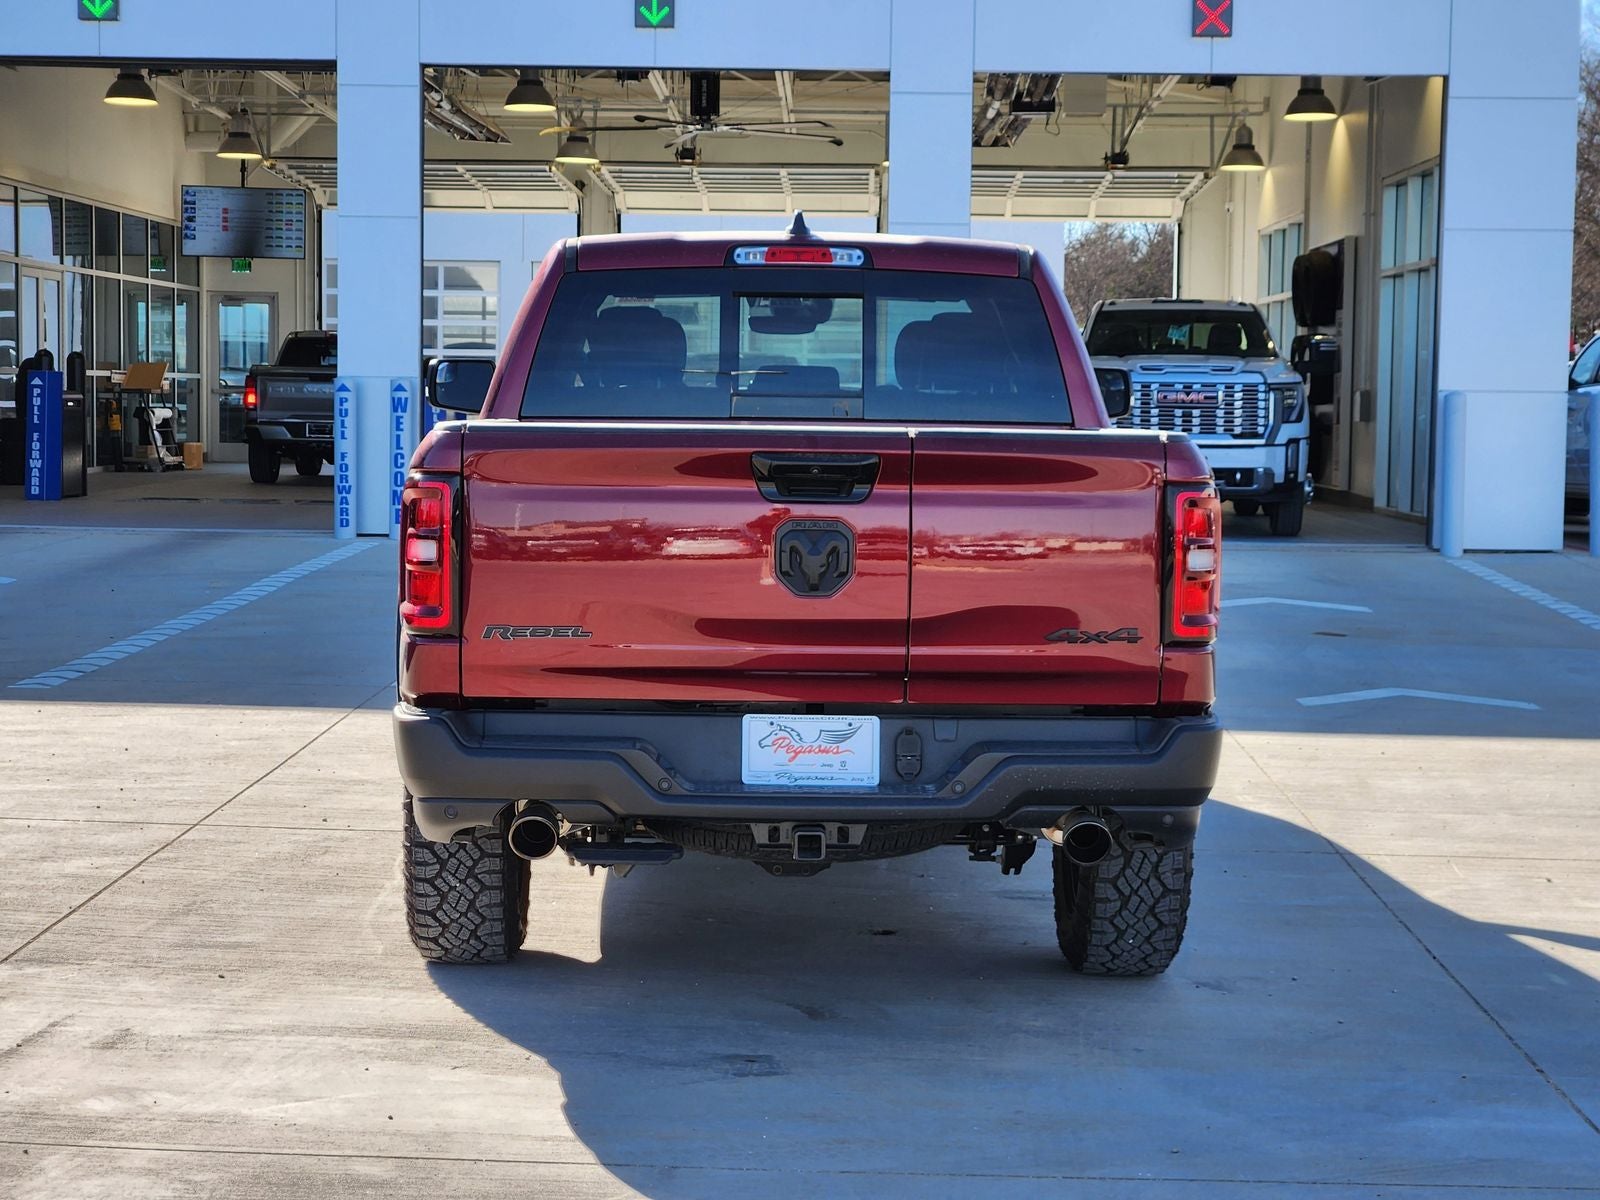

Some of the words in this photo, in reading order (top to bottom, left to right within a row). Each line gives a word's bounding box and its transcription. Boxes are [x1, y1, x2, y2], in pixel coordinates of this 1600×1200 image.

[32, 388, 41, 424] PULL
[1158, 391, 1218, 403] GMC
[338, 397, 349, 440] PULL
[29, 432, 42, 495] FORWARD
[337, 452, 352, 528] FORWARD
[771, 736, 855, 763] Pegasus
[774, 772, 848, 784] Pegasus
